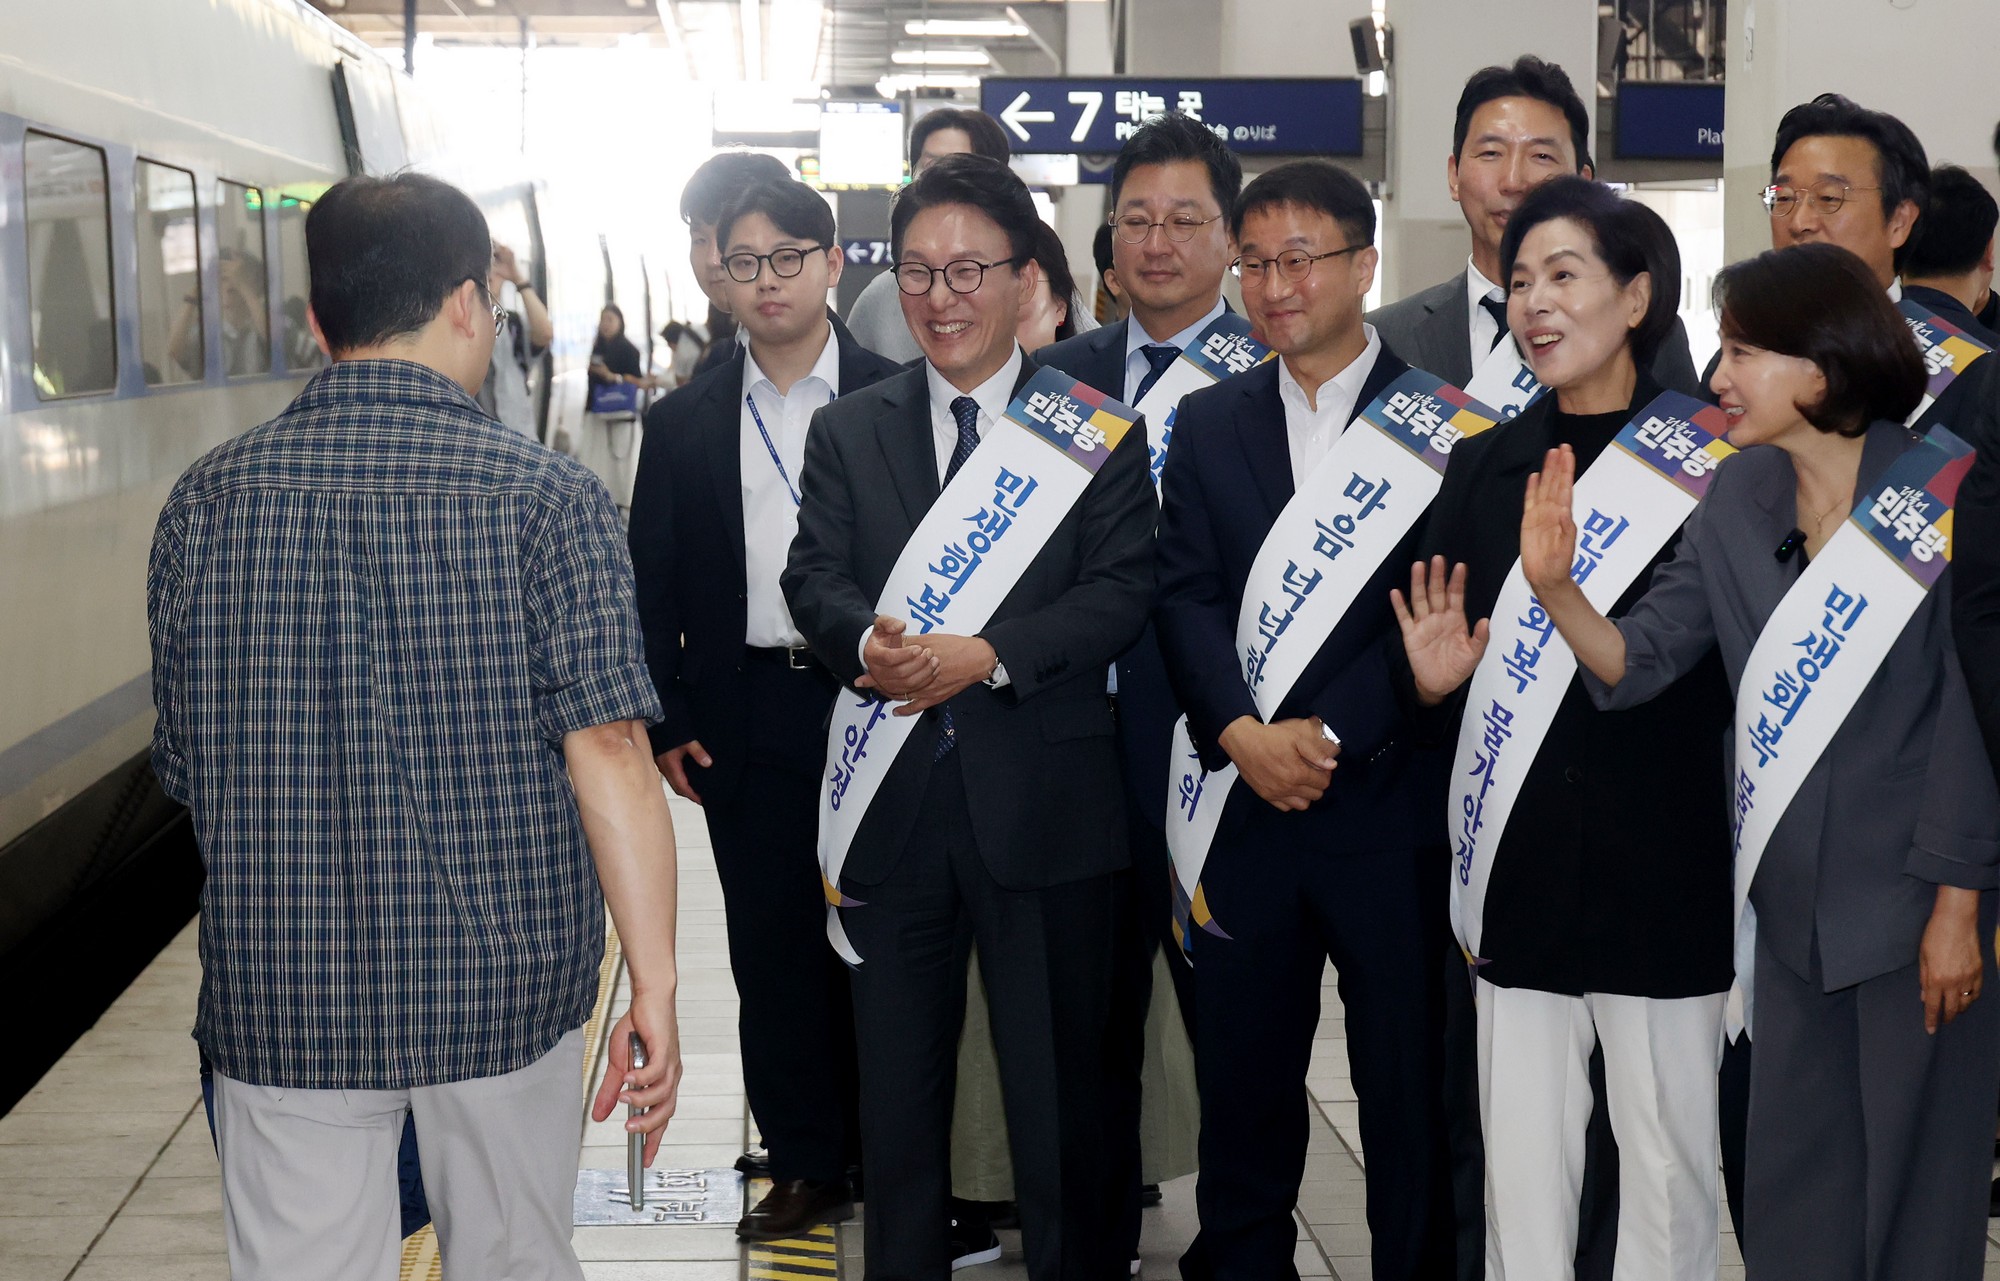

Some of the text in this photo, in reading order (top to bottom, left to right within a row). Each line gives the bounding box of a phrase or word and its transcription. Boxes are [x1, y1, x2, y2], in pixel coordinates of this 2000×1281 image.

[1067, 91, 1103, 142] 7
[1115, 91, 1203, 121] 타는 곳
[1233, 124, 1277, 141] のりば
[870, 242, 885, 264] 7
[1200, 332, 1261, 374] 민주
[1023, 391, 1106, 452] 민주당
[1048, 391, 1079, 413] 더불어
[1381, 391, 1465, 454] 민주당
[1410, 391, 1441, 412] 더불어
[1665, 416, 1697, 438] 더불어
[1634, 415, 1718, 477] 민주당
[1900, 485, 1930, 511] 더불어
[1868, 486, 1949, 562] 민주당
[1246, 472, 1391, 697] 마음 넉넉한
[830, 465, 1039, 811] 민생회복 가안정
[1747, 582, 1868, 768] 민생회복
[1456, 699, 1514, 886] 물가안정
